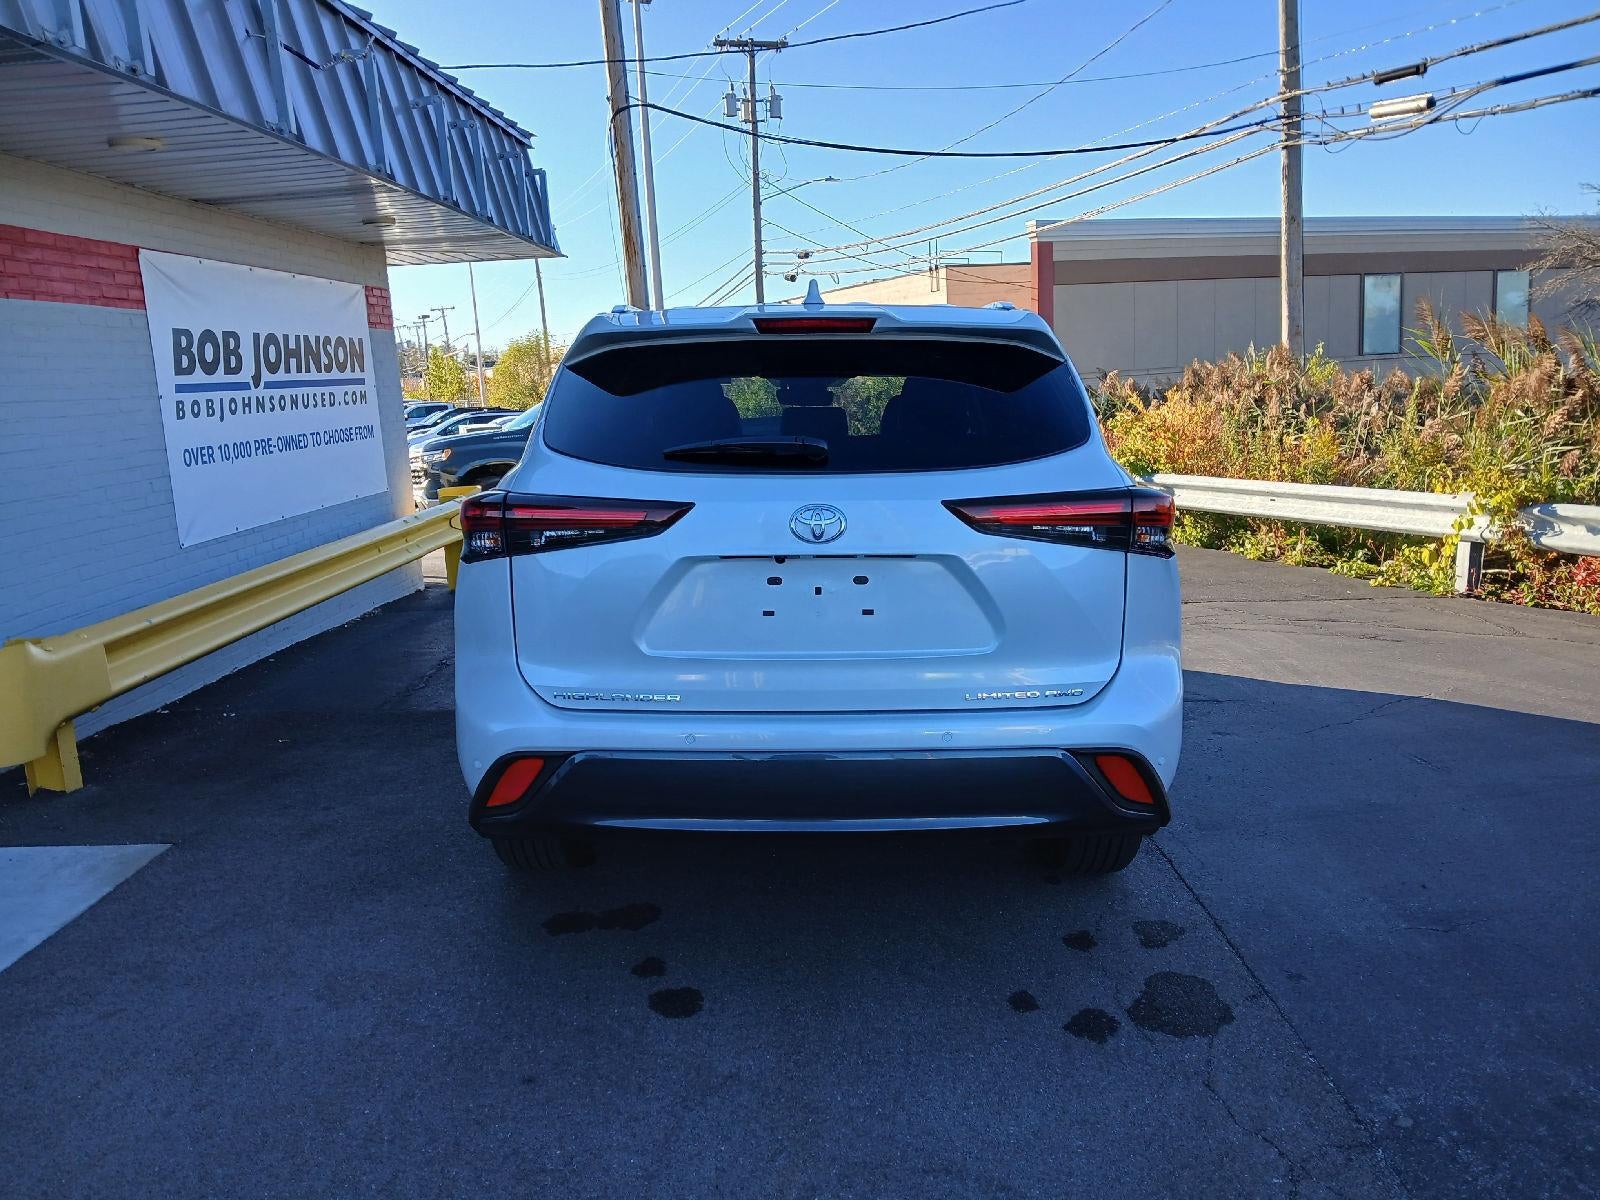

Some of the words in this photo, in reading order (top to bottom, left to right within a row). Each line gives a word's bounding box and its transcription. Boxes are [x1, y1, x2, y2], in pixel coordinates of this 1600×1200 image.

[171, 327, 243, 376] BOB
[250, 332, 365, 389] JOHNSON
[175, 390, 368, 422] BOBJOHNSONUSED.COM
[183, 446, 216, 467] OVER
[217, 442, 252, 464] 10,000
[254, 433, 309, 457] PRE-OWNED
[309, 433, 322, 448] TO
[323, 427, 354, 446] CHOOSE
[354, 424, 375, 441] FROM
[553, 691, 682, 703] HIGHLANDER
[964, 691, 1040, 701] LIMITED
